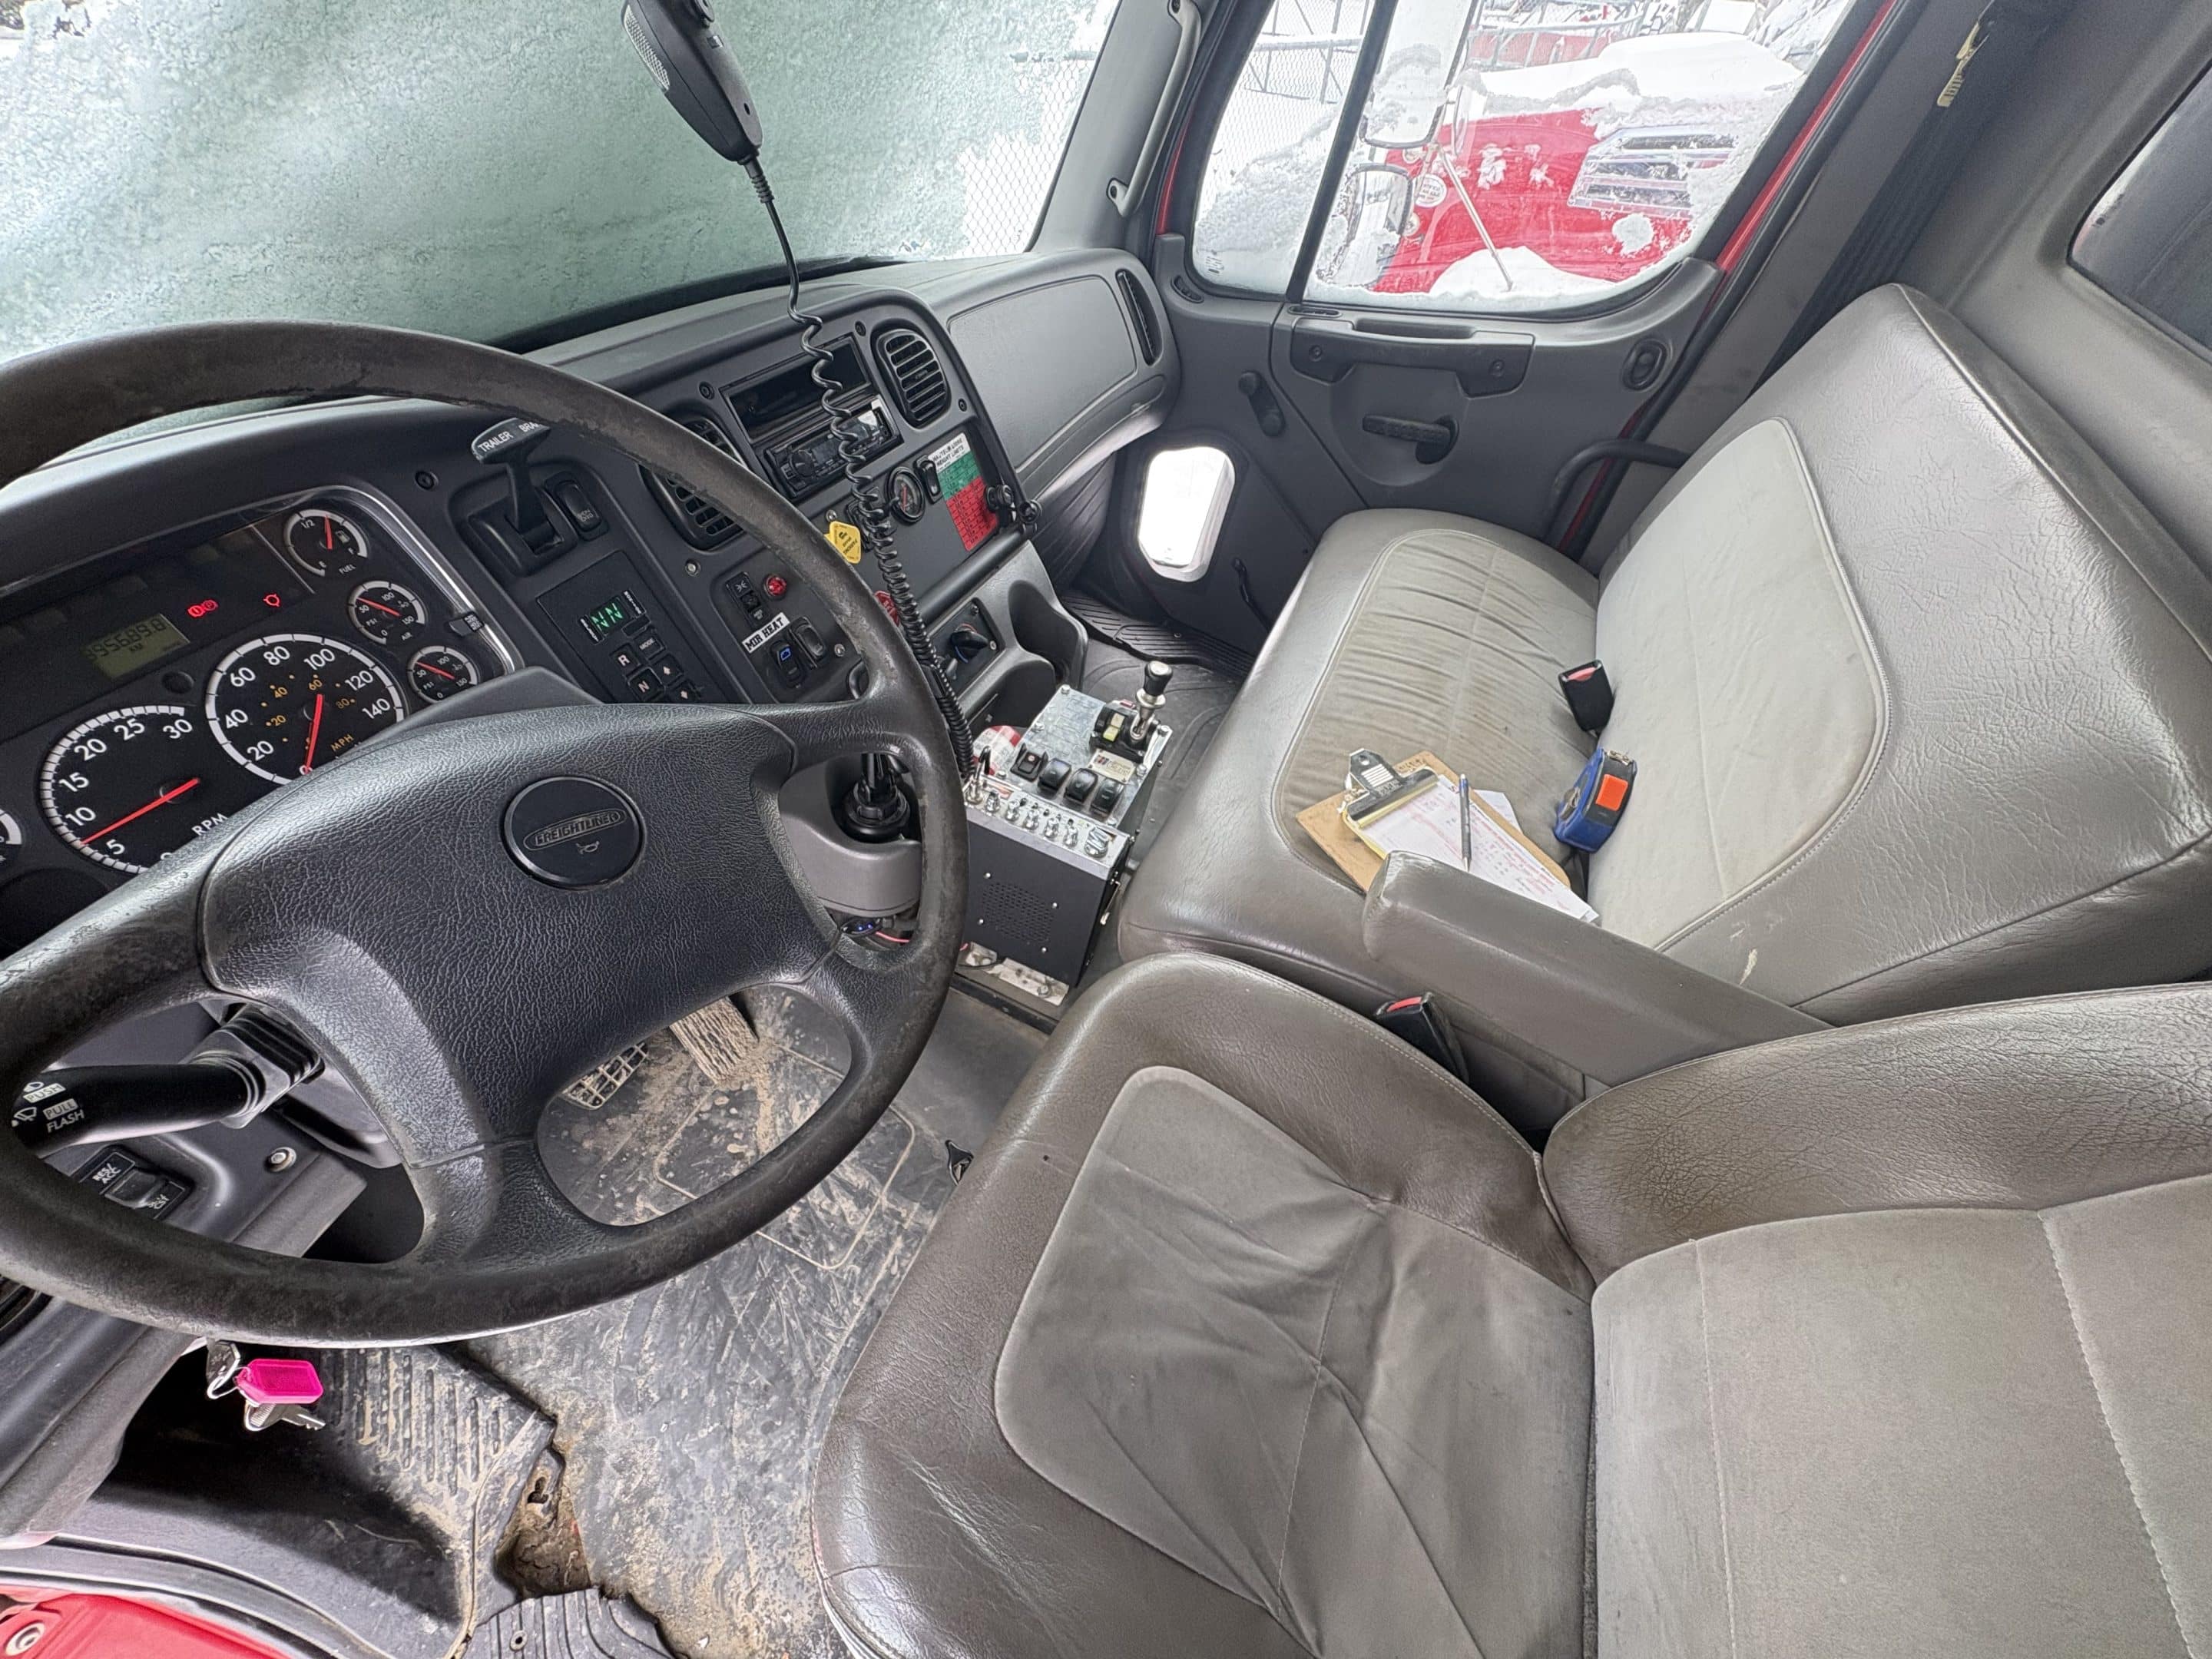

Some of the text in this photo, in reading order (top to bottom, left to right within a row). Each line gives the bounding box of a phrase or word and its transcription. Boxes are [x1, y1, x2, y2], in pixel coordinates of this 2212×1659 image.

[477, 431, 514, 452] TRAILER
[339, 564, 356, 575] FUEL
[381, 591, 395, 602] 100
[359, 604, 369, 614] 50
[366, 618, 378, 627] PSI
[401, 615, 415, 625] 150
[401, 631, 413, 641] AIR
[745, 617, 785, 651] MIR HEAT
[263, 645, 291, 666] 80
[303, 647, 336, 671] 100
[437, 655, 450, 666] 100
[618, 654, 631, 667] R
[230, 667, 257, 687] 60
[344, 670, 374, 691] 120
[417, 669, 427, 677] 50
[273, 687, 288, 699] 40
[309, 679, 323, 691] 60
[423, 681, 435, 690] PSI
[638, 680, 650, 693] N
[336, 698, 350, 710] 80
[363, 697, 391, 720] 140
[224, 708, 249, 729] 40
[270, 714, 286, 727] 20
[113, 718, 145, 741] 25
[163, 719, 193, 740] 30
[74, 738, 108, 761] 20
[247, 740, 274, 761] 20
[330, 734, 354, 753] MPH
[58, 772, 90, 793] 15
[65, 806, 96, 826] 10
[191, 812, 228, 836] RPM
[535, 813, 619, 846] FREIGHTLINER
[106, 839, 125, 855] 5
[26, 1083, 63, 1101] PUSH
[45, 1101, 76, 1118] PULL
[47, 1109, 85, 1133] FLASH
[92, 1163, 113, 1181] RES/
[101, 1167, 121, 1184] ACC
